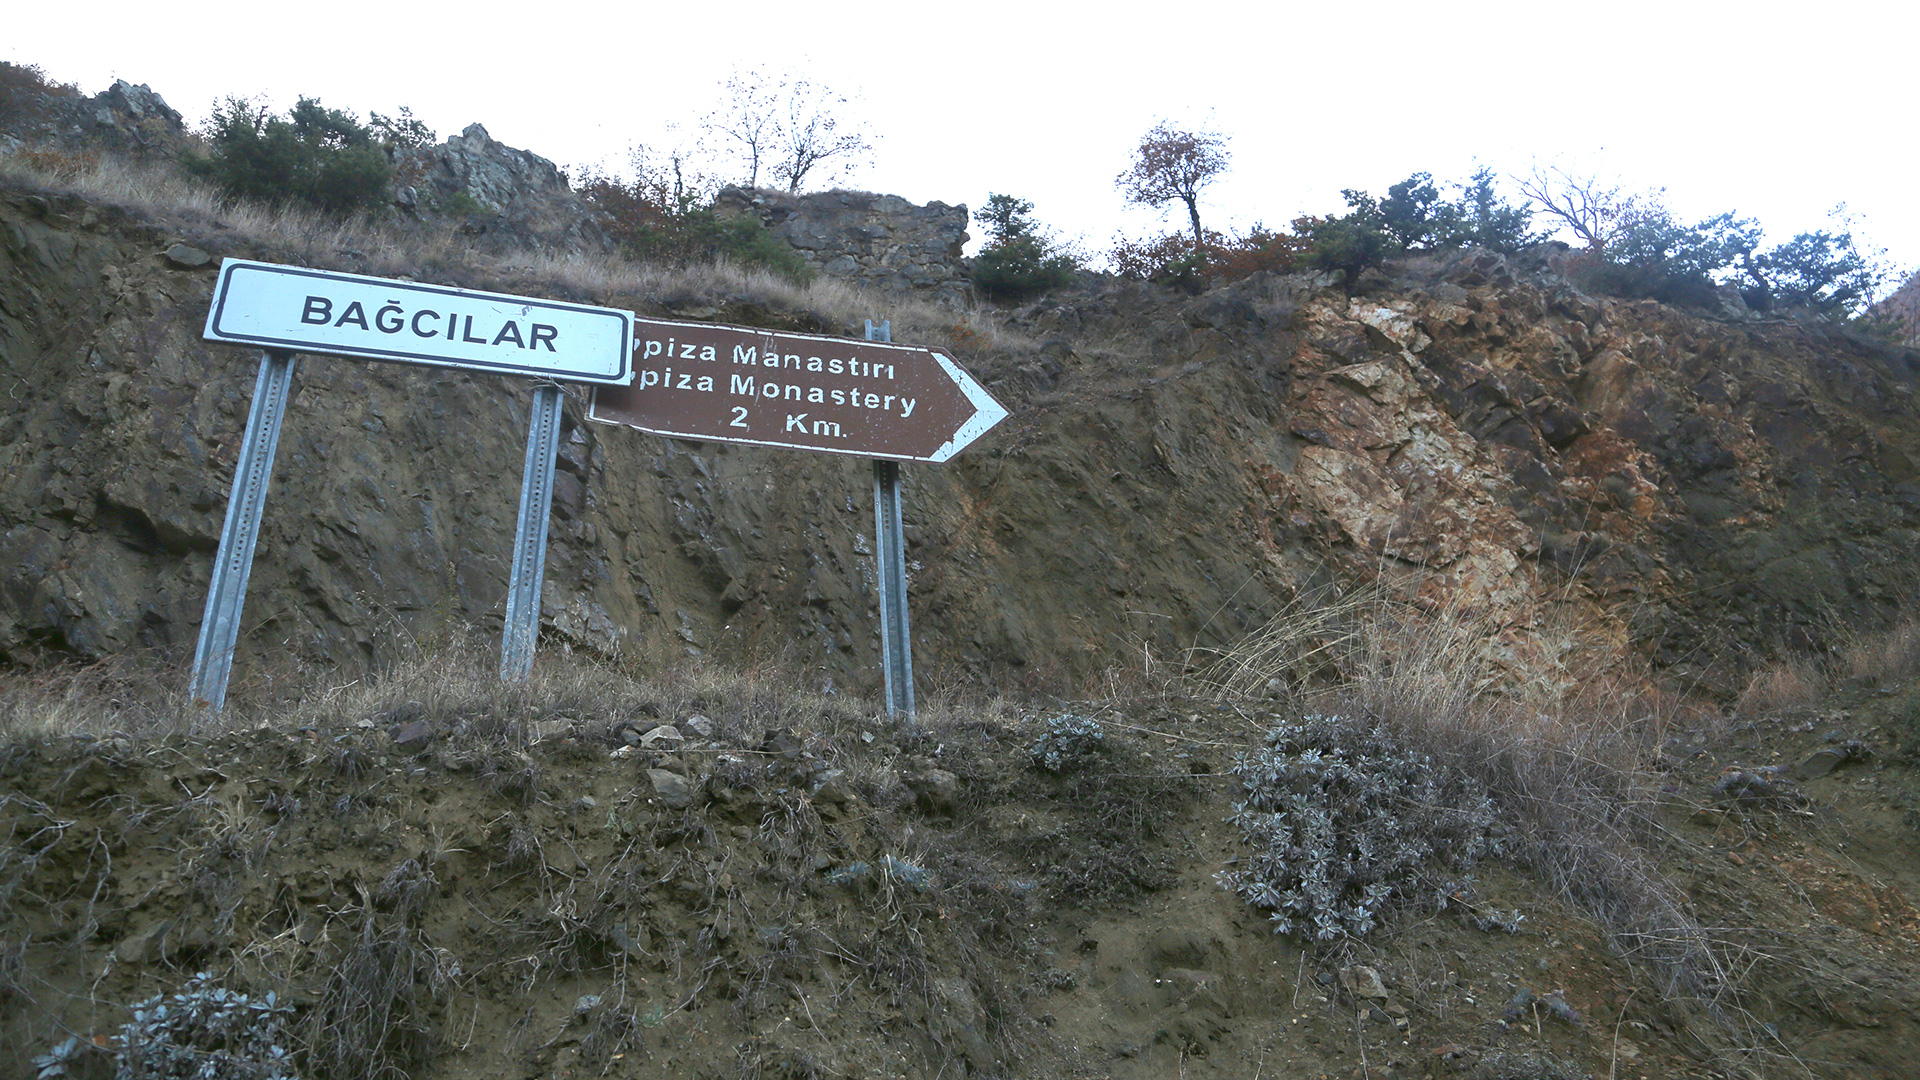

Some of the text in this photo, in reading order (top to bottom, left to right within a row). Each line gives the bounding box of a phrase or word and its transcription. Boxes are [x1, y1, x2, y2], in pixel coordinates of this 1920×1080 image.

[300, 295, 559, 353] BAĞCILAR
[630, 367, 917, 418] piza Monastery
[729, 406, 848, 438] 2 Km.
